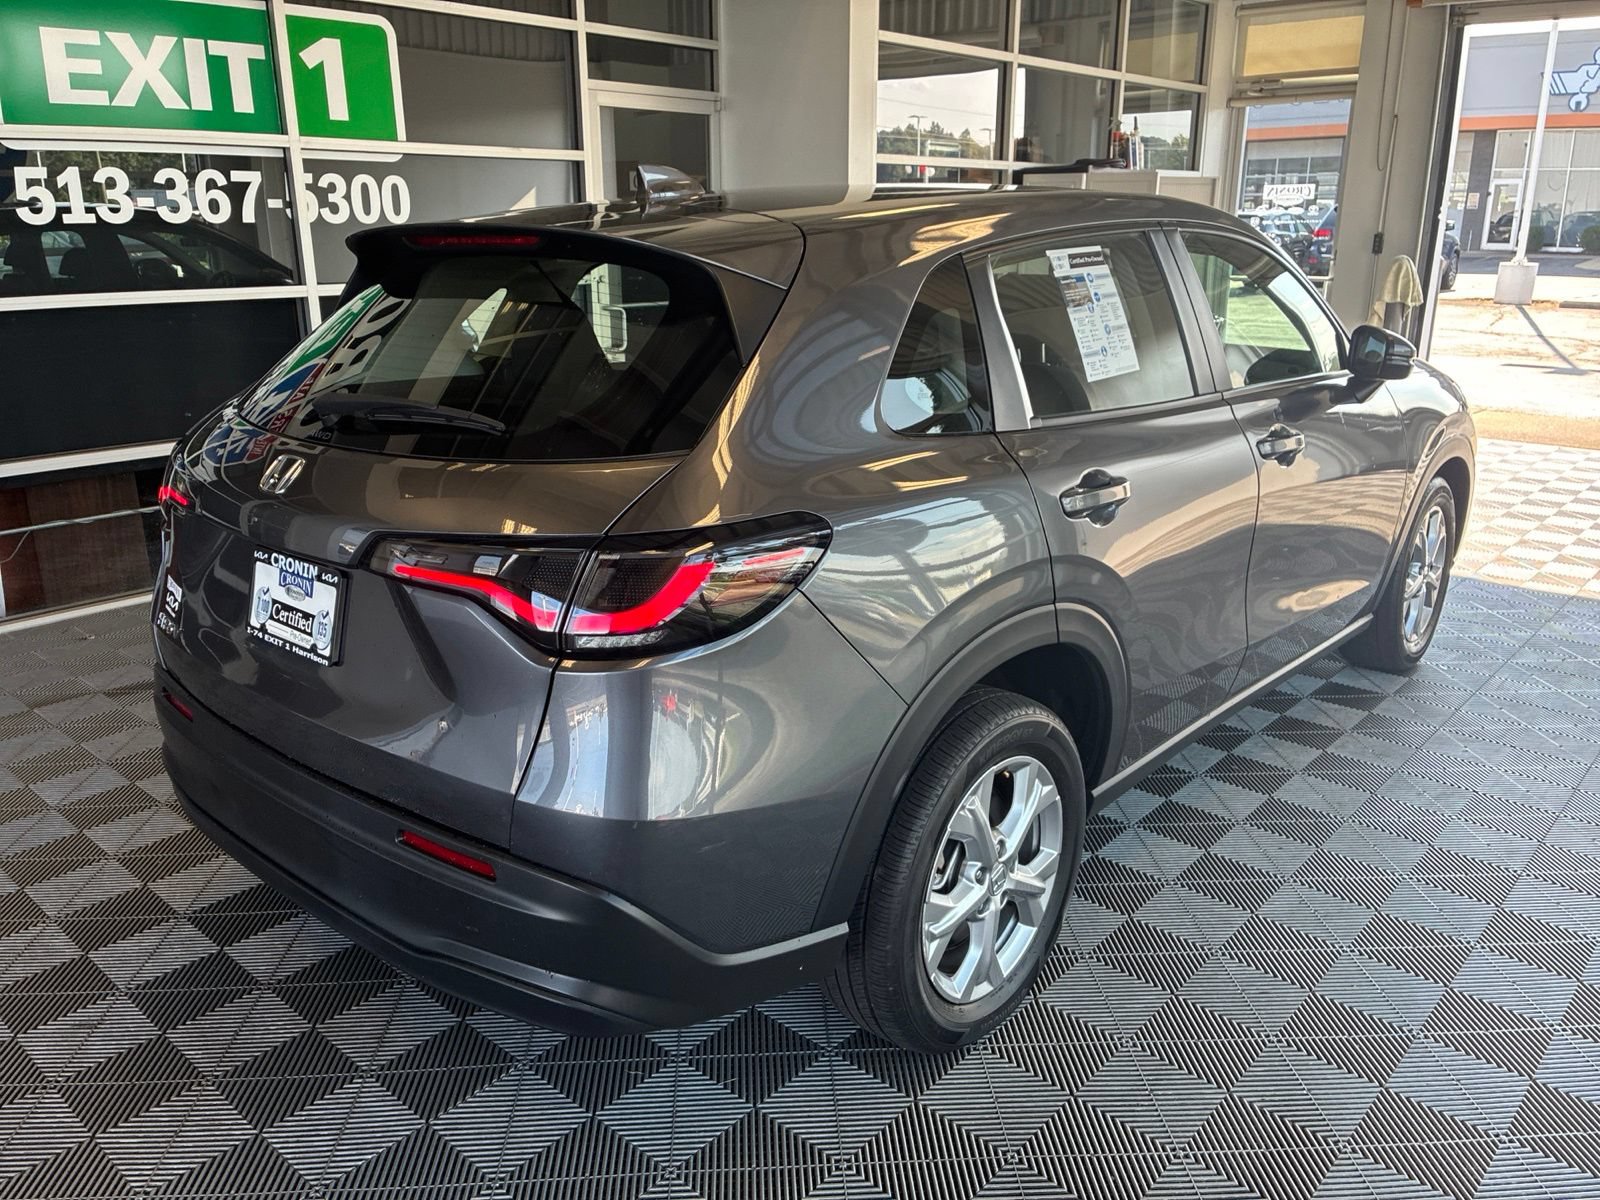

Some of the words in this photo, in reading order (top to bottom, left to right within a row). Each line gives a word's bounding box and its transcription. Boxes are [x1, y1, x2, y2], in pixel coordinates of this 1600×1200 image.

[39, 26, 266, 115] EXIT
[299, 37, 350, 122] 1
[13, 165, 412, 226] 513-367-5300
[271, 552, 318, 579] CRONIN
[280, 572, 313, 597] CRONIN
[272, 603, 313, 633] Certified
[264, 634, 284, 648] EXIT
[292, 646, 329, 666] Harrison
